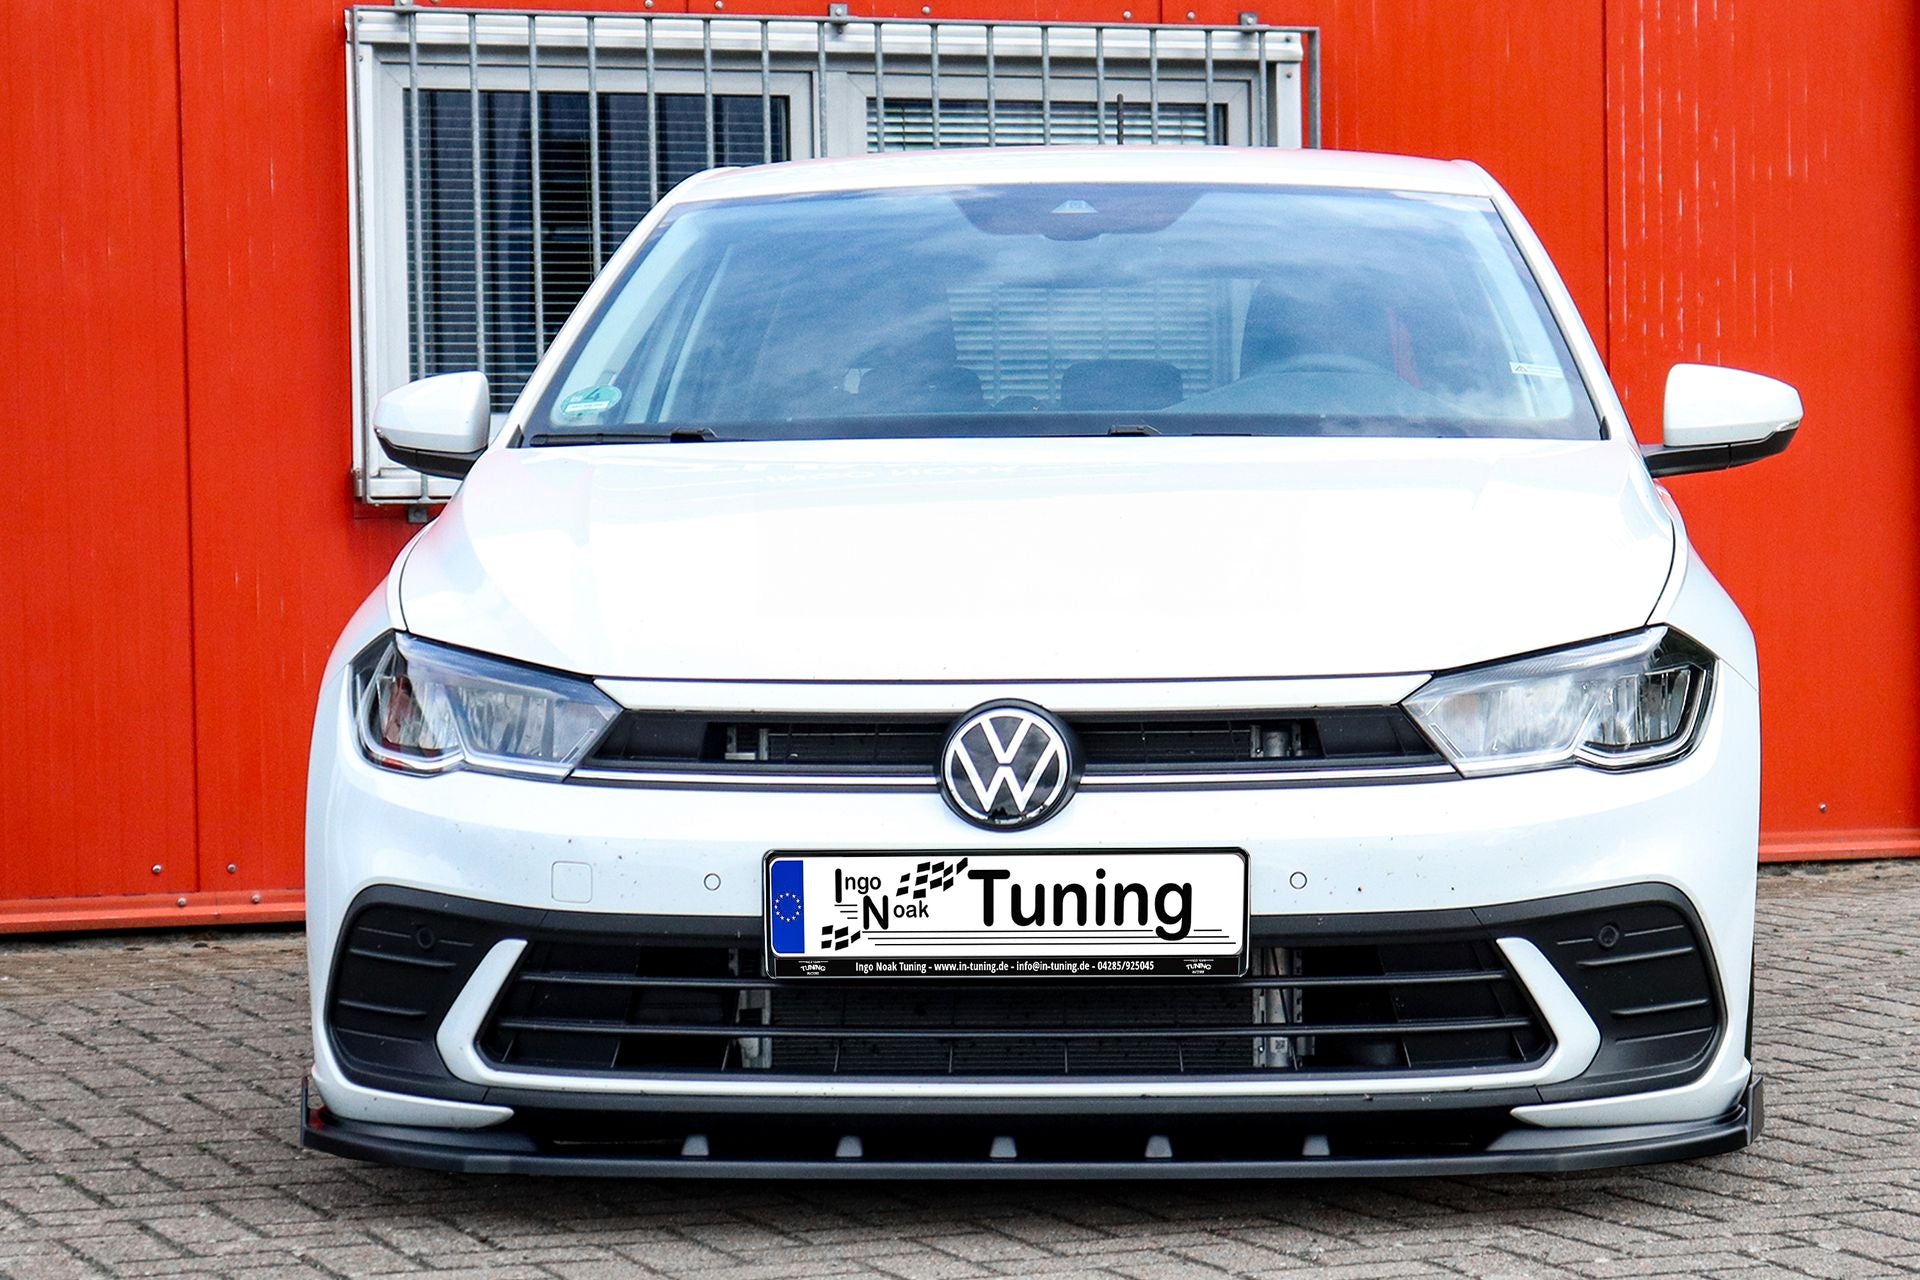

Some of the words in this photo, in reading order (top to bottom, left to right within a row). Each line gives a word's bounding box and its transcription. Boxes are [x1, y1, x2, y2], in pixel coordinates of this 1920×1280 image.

[946, 709, 1065, 820] VW
[834, 868, 882, 904] Ingo
[862, 894, 930, 931] Noak
[967, 868, 1193, 942] Tuning
[855, 961, 874, 974] Ingo
[875, 961, 898, 972] Noak
[898, 961, 927, 974] Tuning
[933, 960, 1009, 974] www.in-tuning.de
[1016, 960, 1090, 974] info@in-tuning.de
[1097, 960, 1155, 972] 04285/925045
